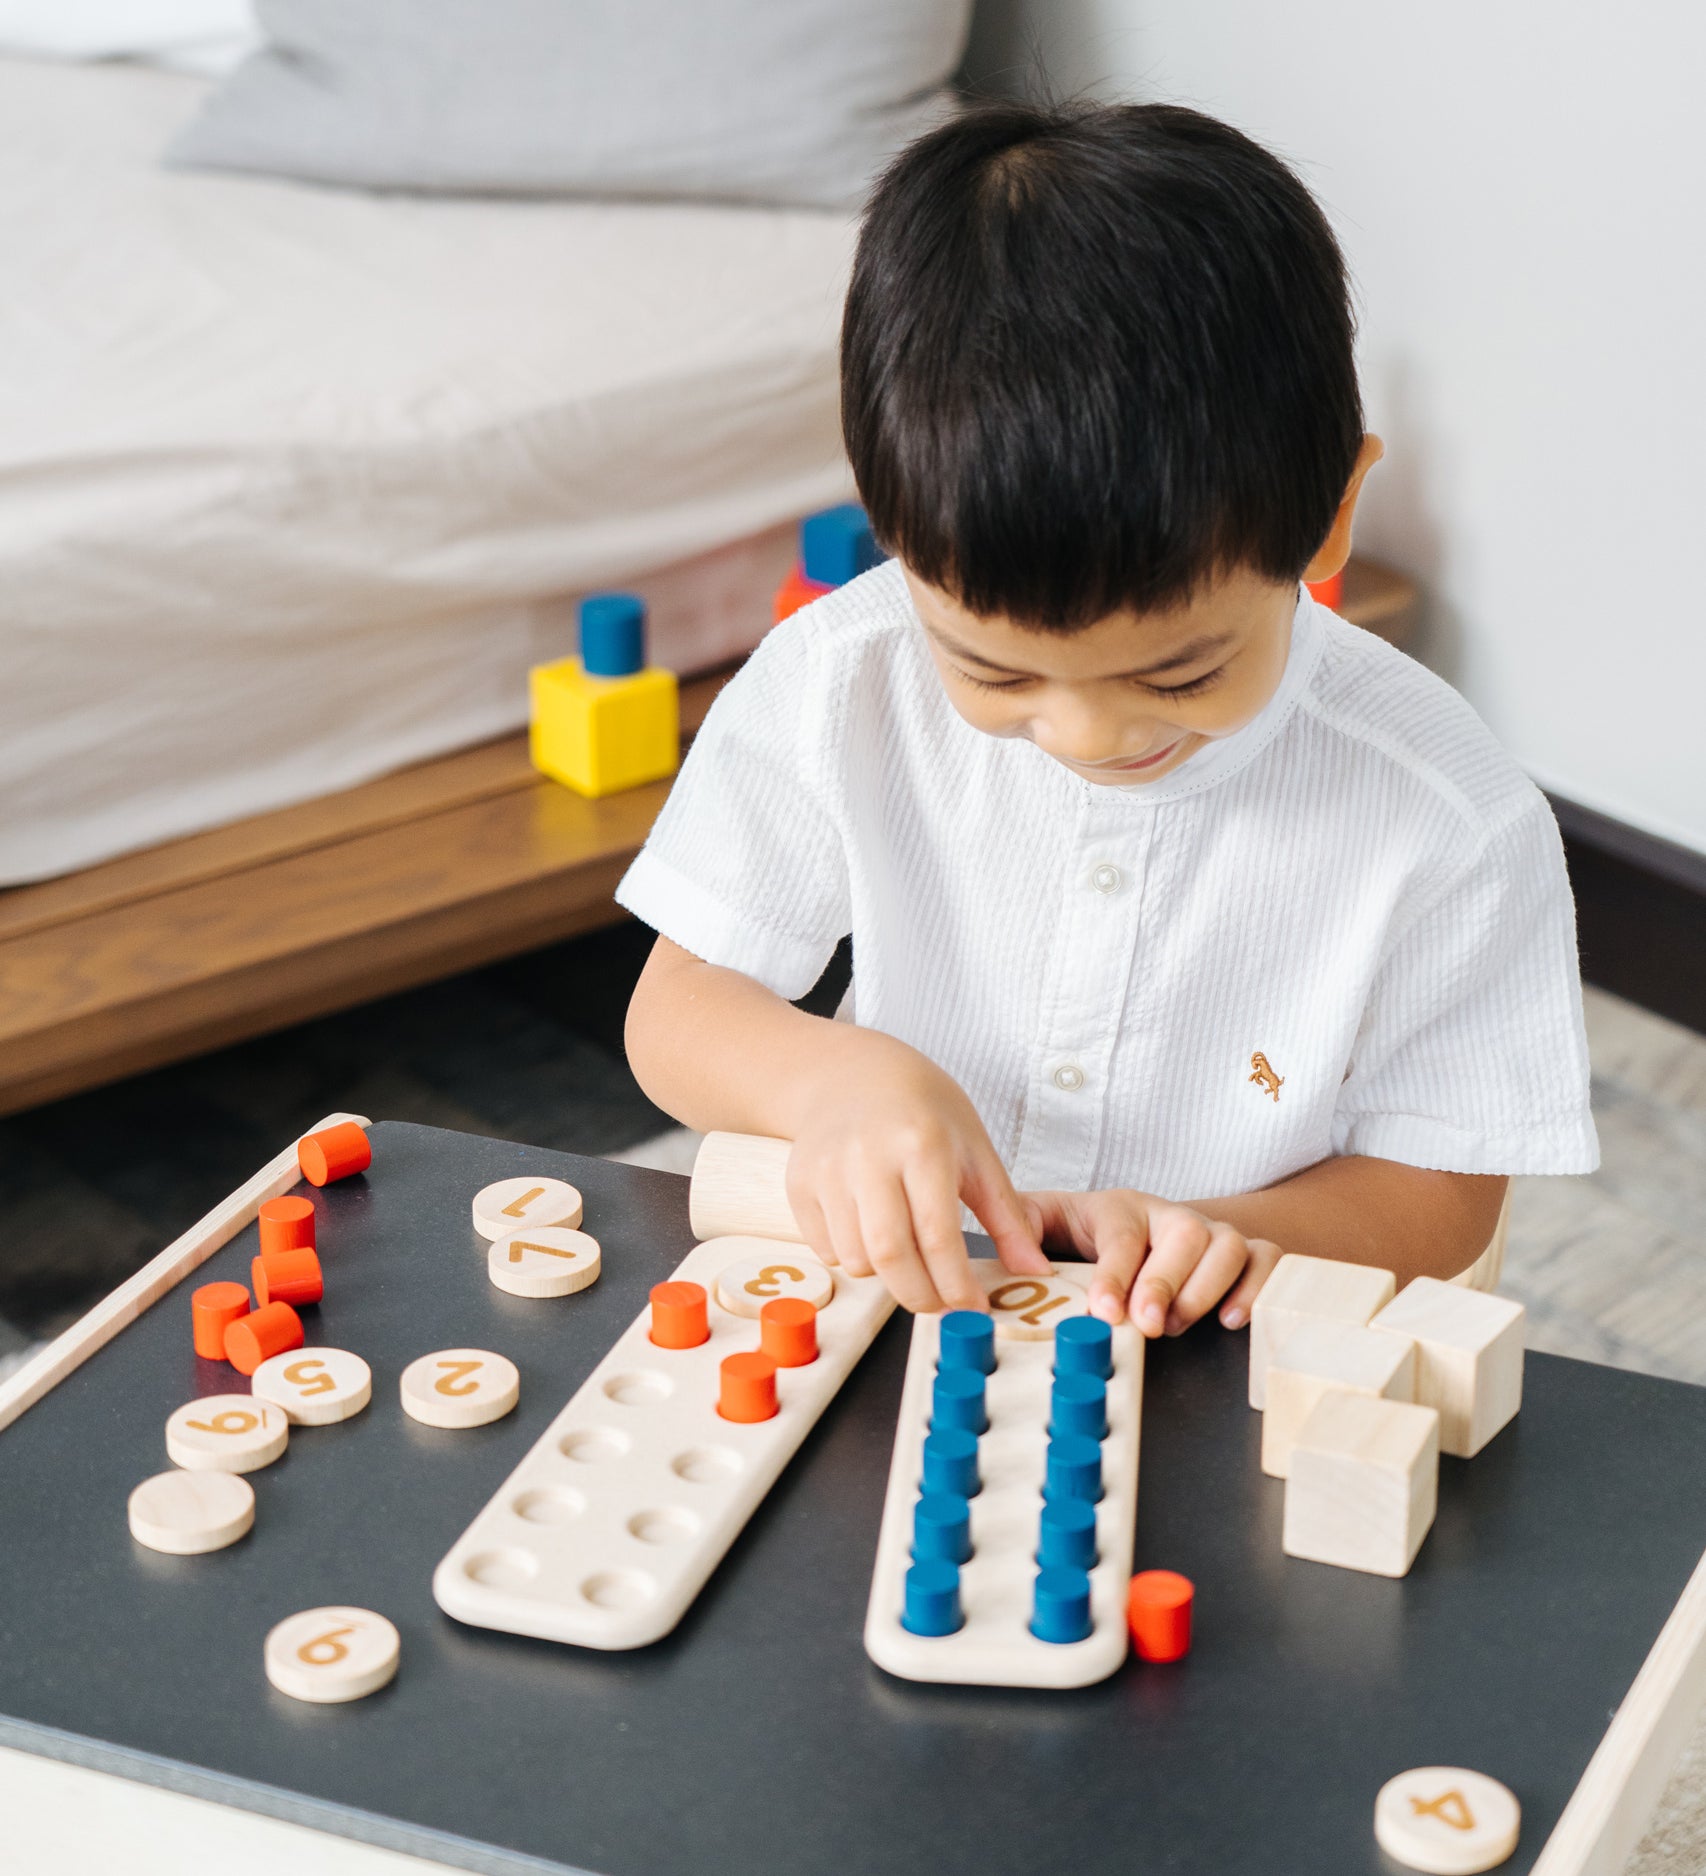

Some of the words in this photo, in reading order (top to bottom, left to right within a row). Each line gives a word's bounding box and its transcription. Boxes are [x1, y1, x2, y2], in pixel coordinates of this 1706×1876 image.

[501, 1186, 547, 1219] 1
[508, 1240, 577, 1264] 7
[743, 1264, 806, 1298] 3
[989, 1279, 1072, 1327] 10
[283, 1359, 337, 1397] 5
[433, 1360, 484, 1397] 2
[1408, 1788, 1477, 1832] 4
